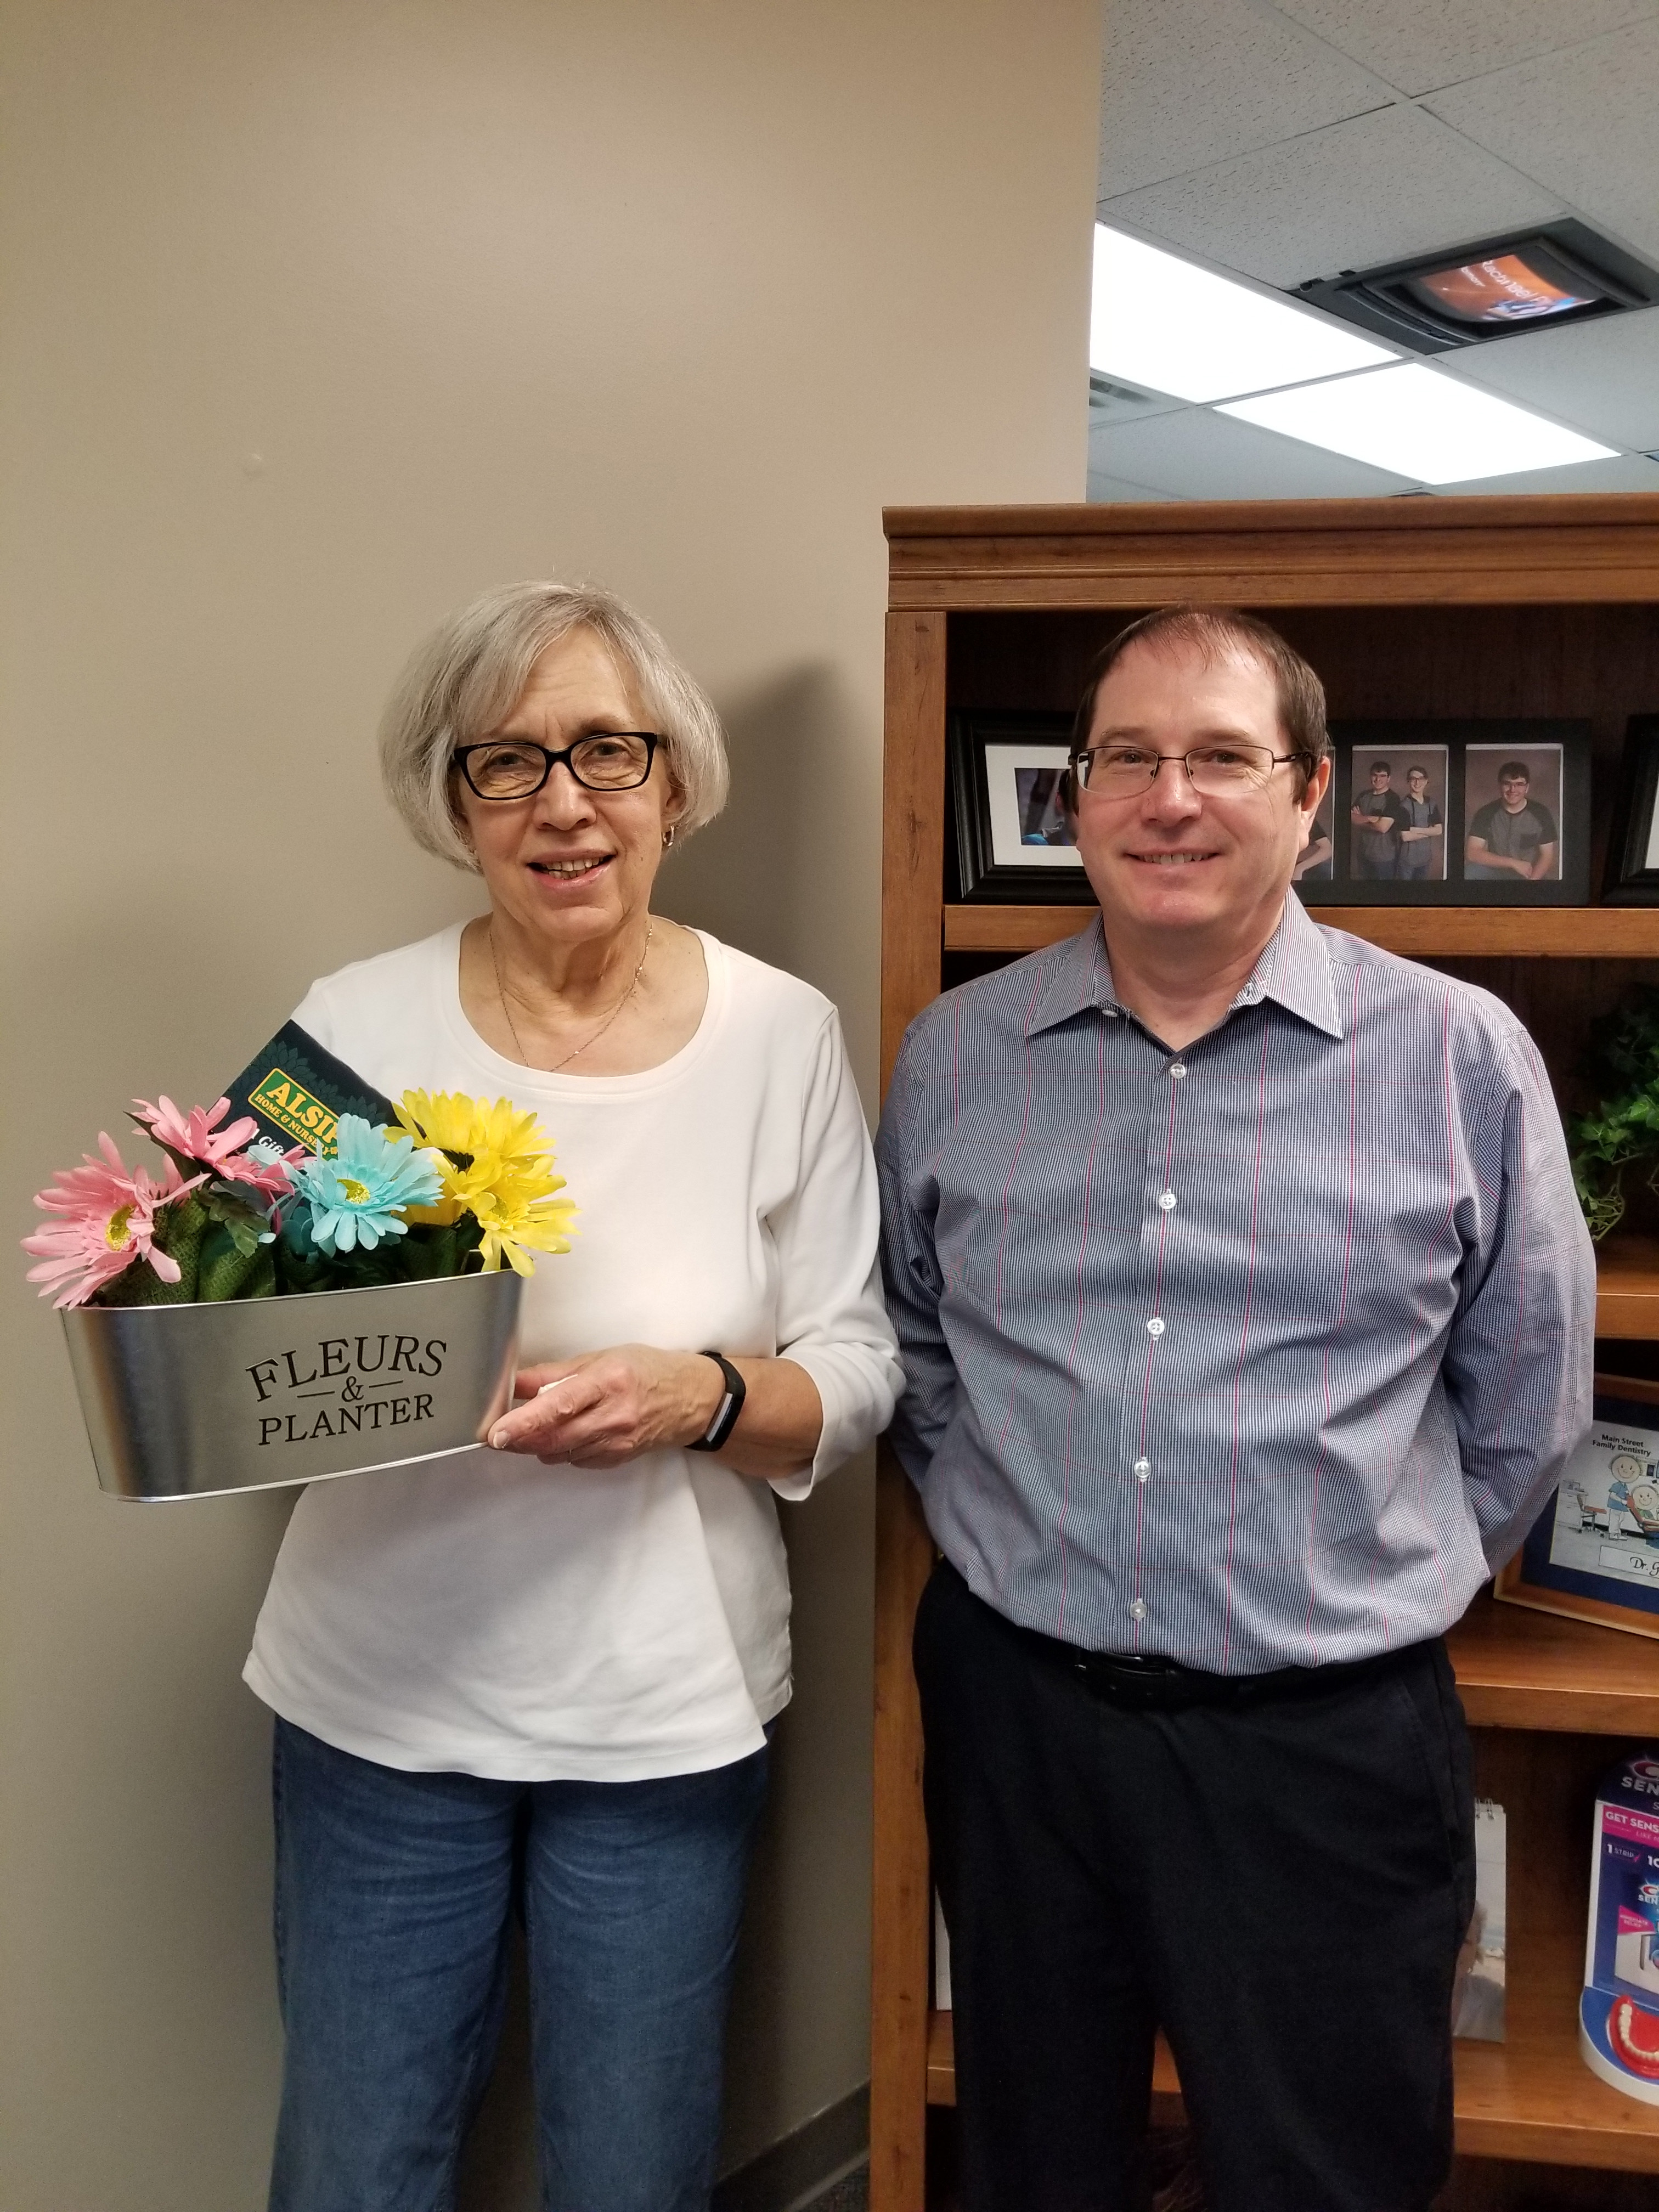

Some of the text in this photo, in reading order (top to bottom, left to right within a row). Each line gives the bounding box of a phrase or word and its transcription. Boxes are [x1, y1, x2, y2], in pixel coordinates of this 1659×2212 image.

[254, 1093, 283, 1118] HOME
[280, 1114, 291, 1124] &
[288, 1120, 331, 1155] NURSEY
[245, 1334, 447, 1402] FLEURS
[341, 1375, 364, 1402] &
[258, 1393, 435, 1446] PLANTER
[1592, 1440, 1651, 1457] Family Dentistry
[1601, 1434, 1644, 1447] Main Street
[1629, 1556, 1649, 1571] Dr.
[1606, 1812, 1628, 1824] GET
[1607, 1843, 1612, 1854] 1
[1614, 1847, 1634, 1858] STRIP
